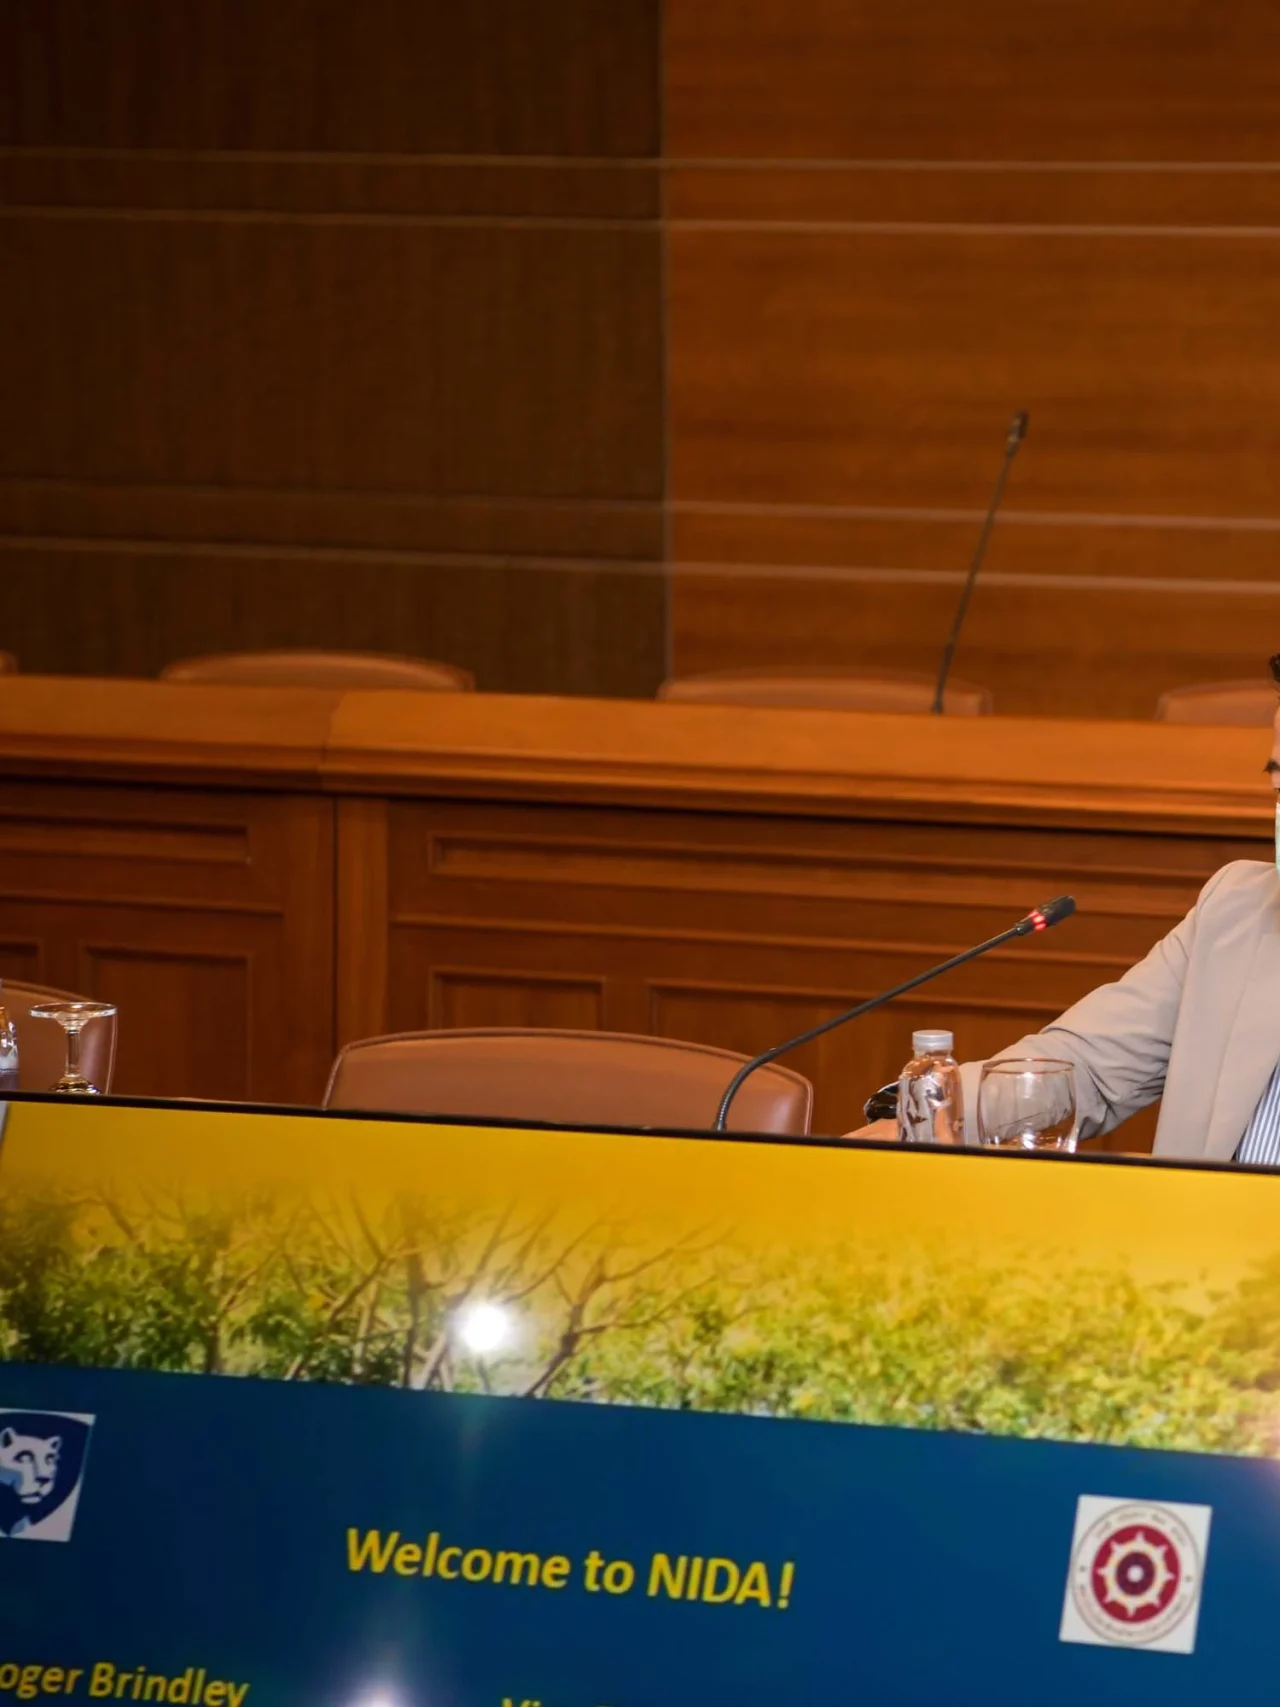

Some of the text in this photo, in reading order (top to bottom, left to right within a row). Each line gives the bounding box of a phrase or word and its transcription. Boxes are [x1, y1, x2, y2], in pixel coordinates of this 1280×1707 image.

[346, 1527, 795, 1609] Welcome to NIDA!
[88, 1661, 250, 1707] Brindley
